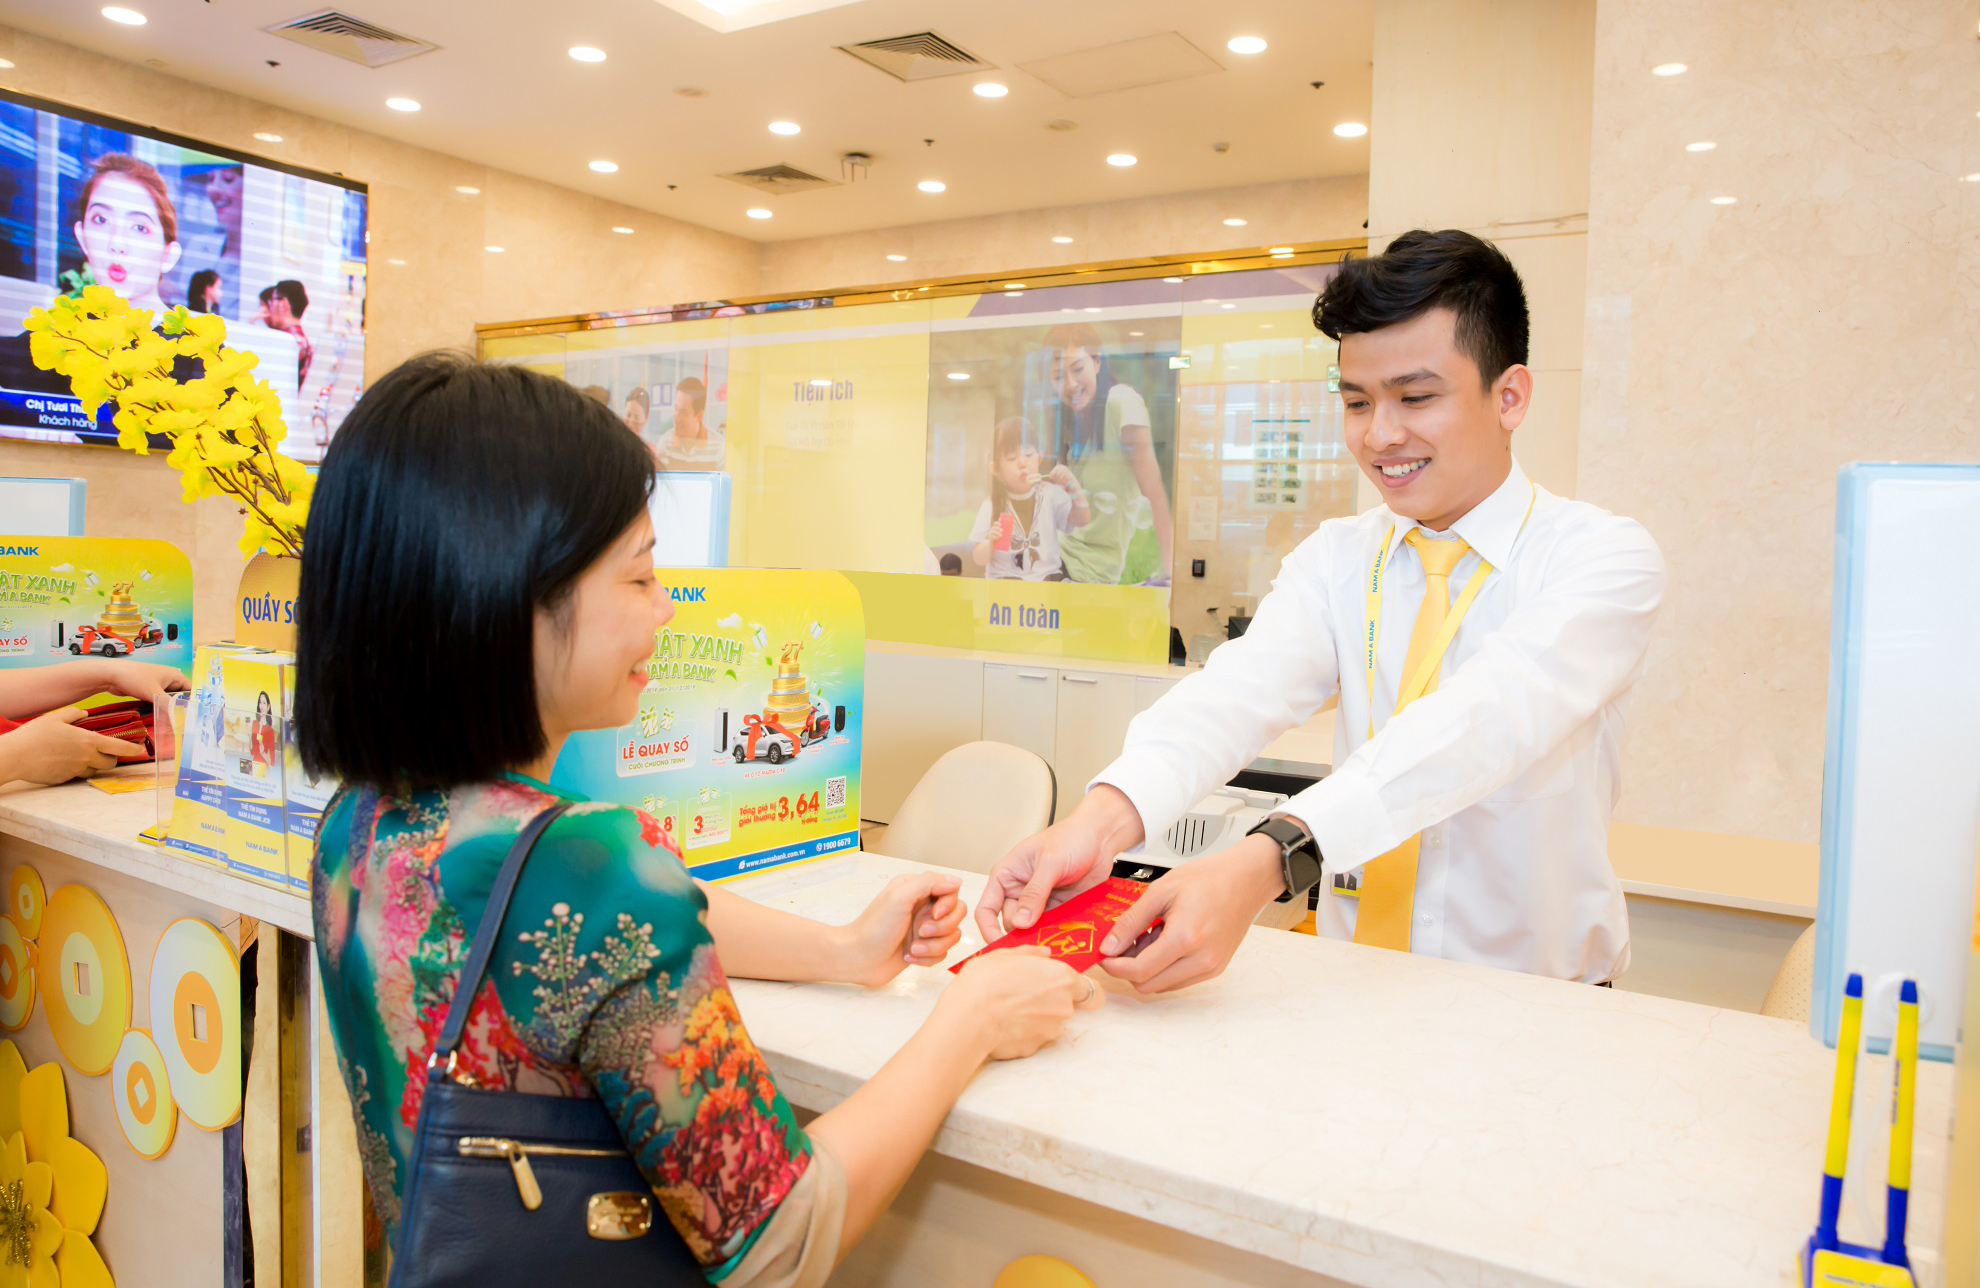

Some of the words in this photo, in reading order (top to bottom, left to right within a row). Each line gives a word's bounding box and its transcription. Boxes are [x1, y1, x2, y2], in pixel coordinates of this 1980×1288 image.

[25, 399, 45, 412] Chị
[46, 400, 69, 412] Tươi
[39, 414, 71, 426] Khách
[72, 417, 98, 431] hàng
[1375, 549, 1384, 568] BANK
[27, 575, 76, 595] XANH
[112, 581, 134, 596] 27
[20, 592, 50, 605] BANK
[989, 602, 1011, 626] An
[1019, 603, 1060, 630] toàn
[13, 635, 29, 646] SỐ
[690, 634, 744, 665] XANH
[781, 640, 804, 663] 27
[683, 662, 716, 683] BANK
[623, 741, 635, 759] LỄ
[638, 742, 671, 757] QUAY
[673, 735, 690, 753] SỐ
[241, 802, 249, 810] THẺ
[739, 805, 756, 816] Tổng
[778, 790, 820, 820] 3,64
[251, 814, 262, 822] BANK
[693, 814, 704, 834] 3
[290, 824, 299, 832] NAM
[245, 840, 258, 850] NAM
[263, 845, 279, 856] BANK
[823, 841, 837, 851] 1900
[837, 837, 851, 848] 6679
[746, 849, 806, 868] www.namabank.com.vn
